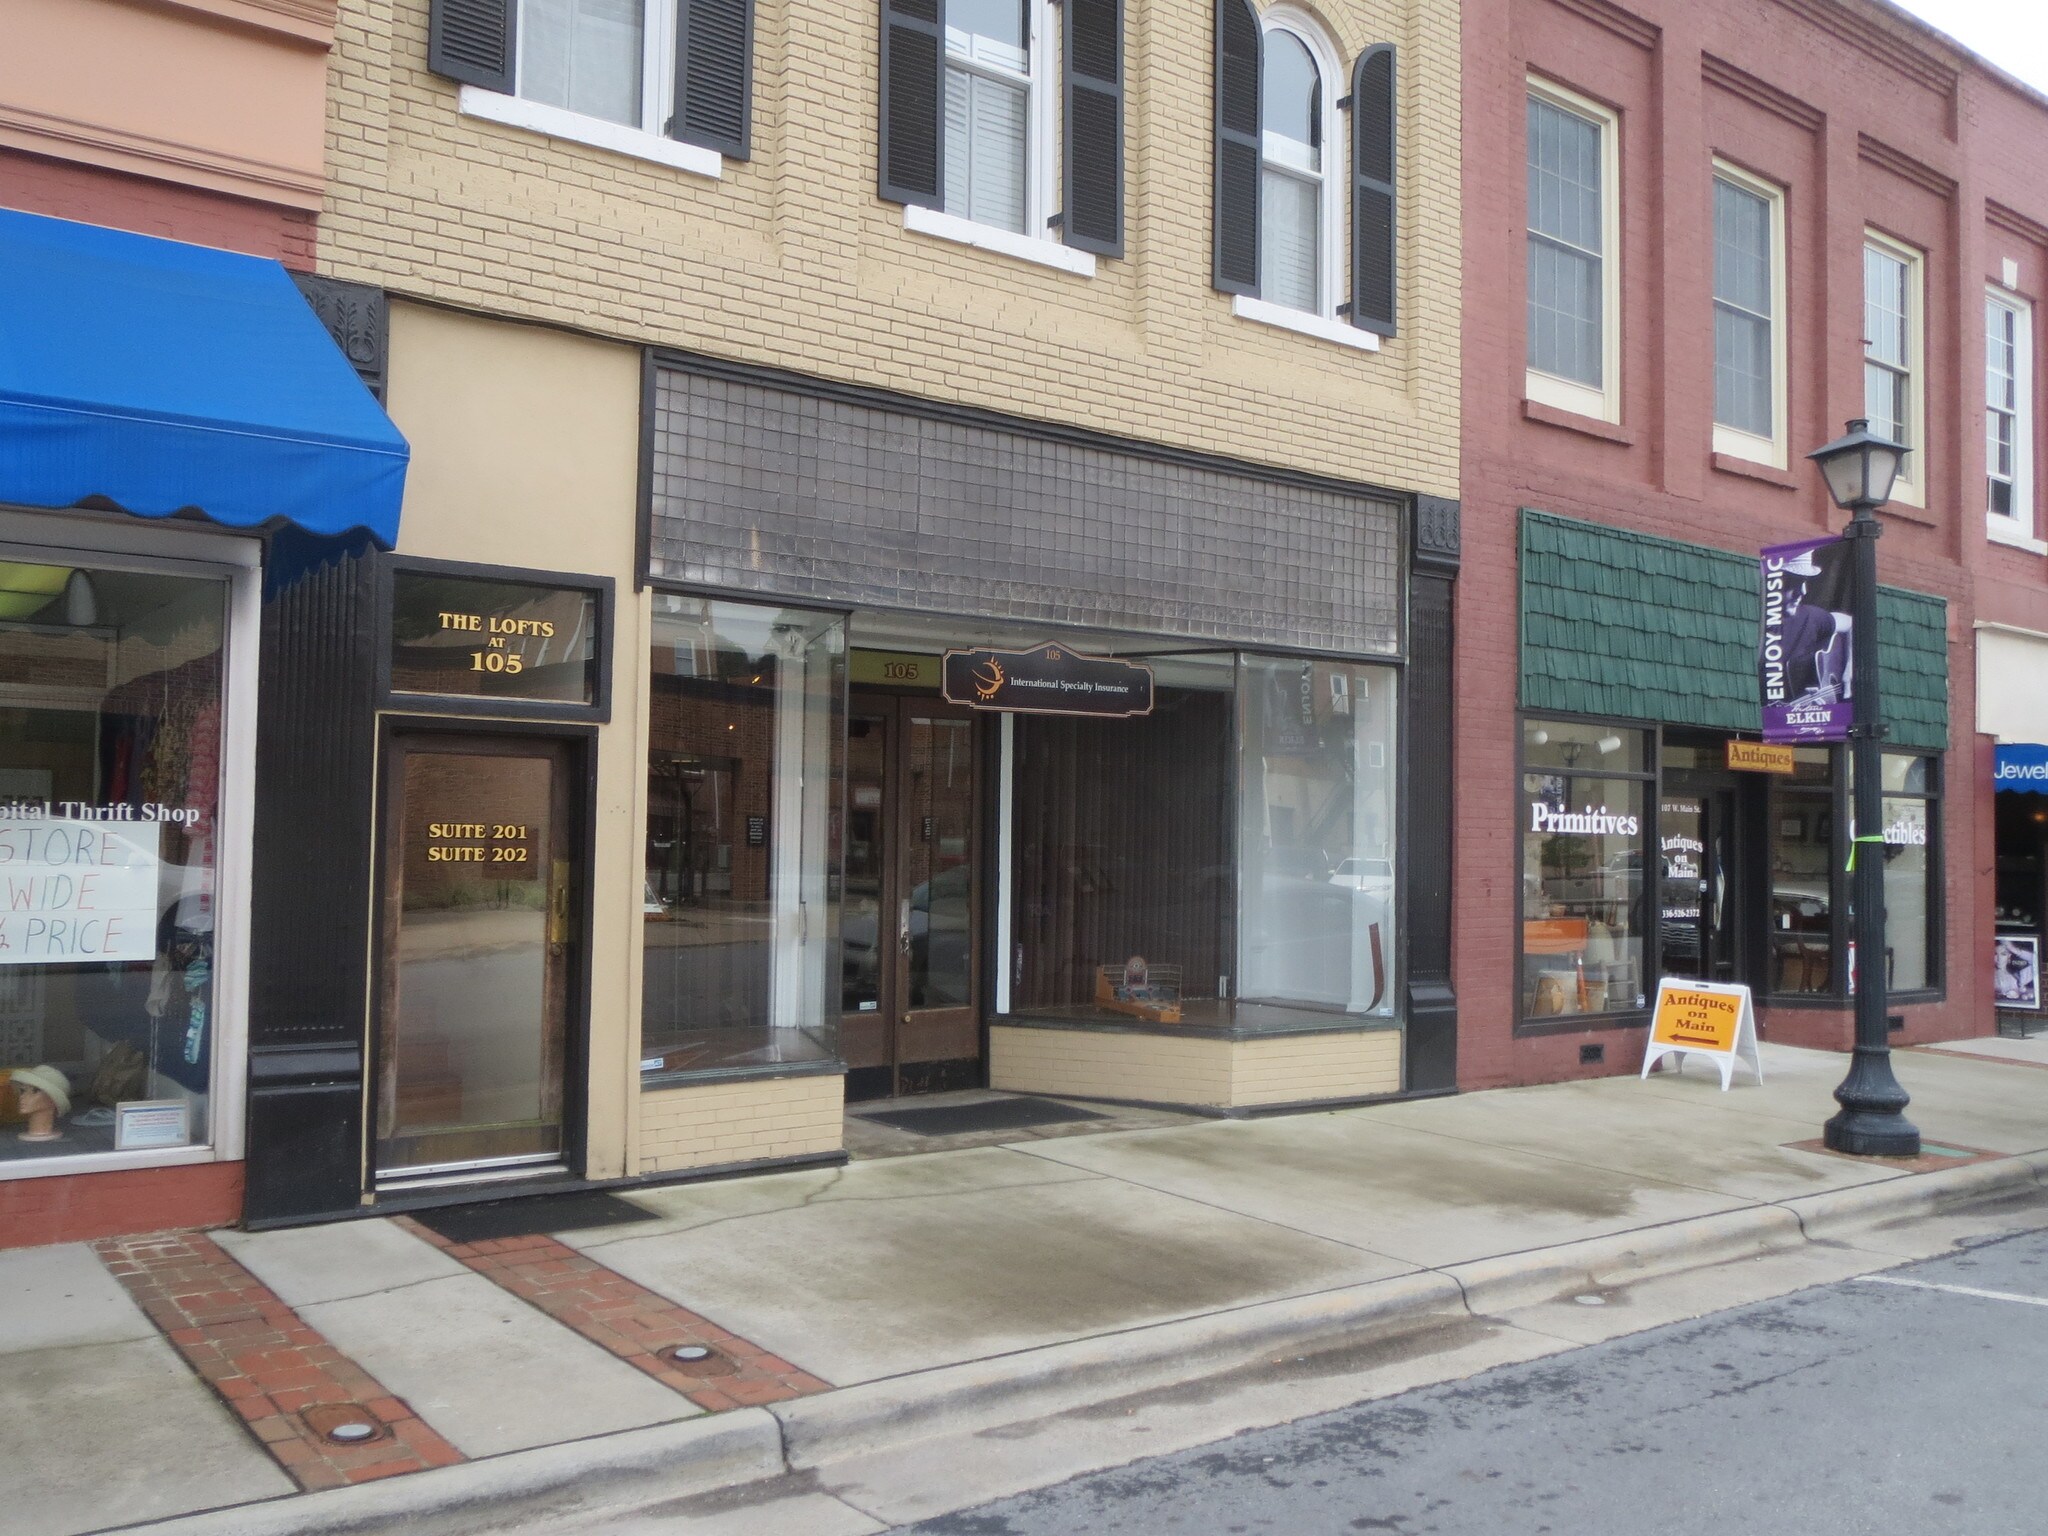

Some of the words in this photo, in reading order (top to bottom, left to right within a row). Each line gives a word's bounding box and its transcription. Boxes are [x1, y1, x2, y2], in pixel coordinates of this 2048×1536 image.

[1766, 557, 1784, 626] MUSIC
[438, 612, 482, 632] THE
[489, 617, 555, 637] LOFTS
[487, 637, 506, 648] AT
[469, 652, 523, 674] 105
[1046, 650, 1061, 661] 105
[884, 662, 919, 680] 105
[1765, 632, 1785, 700] ENJOY
[1010, 676, 1059, 689] International
[1060, 680, 1094, 693] Specialty
[1095, 682, 1129, 693] Insurance
[1785, 711, 1832, 725] ELKIN
[1731, 745, 1791, 768] Antiques
[1994, 760, 2048, 780] Jewel
[59, 801, 134, 821] Thrift
[141, 803, 200, 827] Shop
[1531, 802, 1638, 835] Primitives
[1680, 805, 1693, 813] Main
[428, 823, 486, 839] SUITE
[492, 825, 528, 839] 201
[0, 828, 118, 866] STORE
[1661, 833, 1704, 853] Antiques
[427, 847, 486, 862] SUITE
[491, 848, 528, 862] 202
[1674, 855, 1688, 863] on
[1668, 865, 1693, 878] Main
[8, 873, 100, 911] WIDE
[25, 917, 123, 955] PRICE
[1665, 994, 1735, 1013] Antiques
[1687, 1009, 1708, 1019] on
[1676, 1019, 1715, 1032] Main
